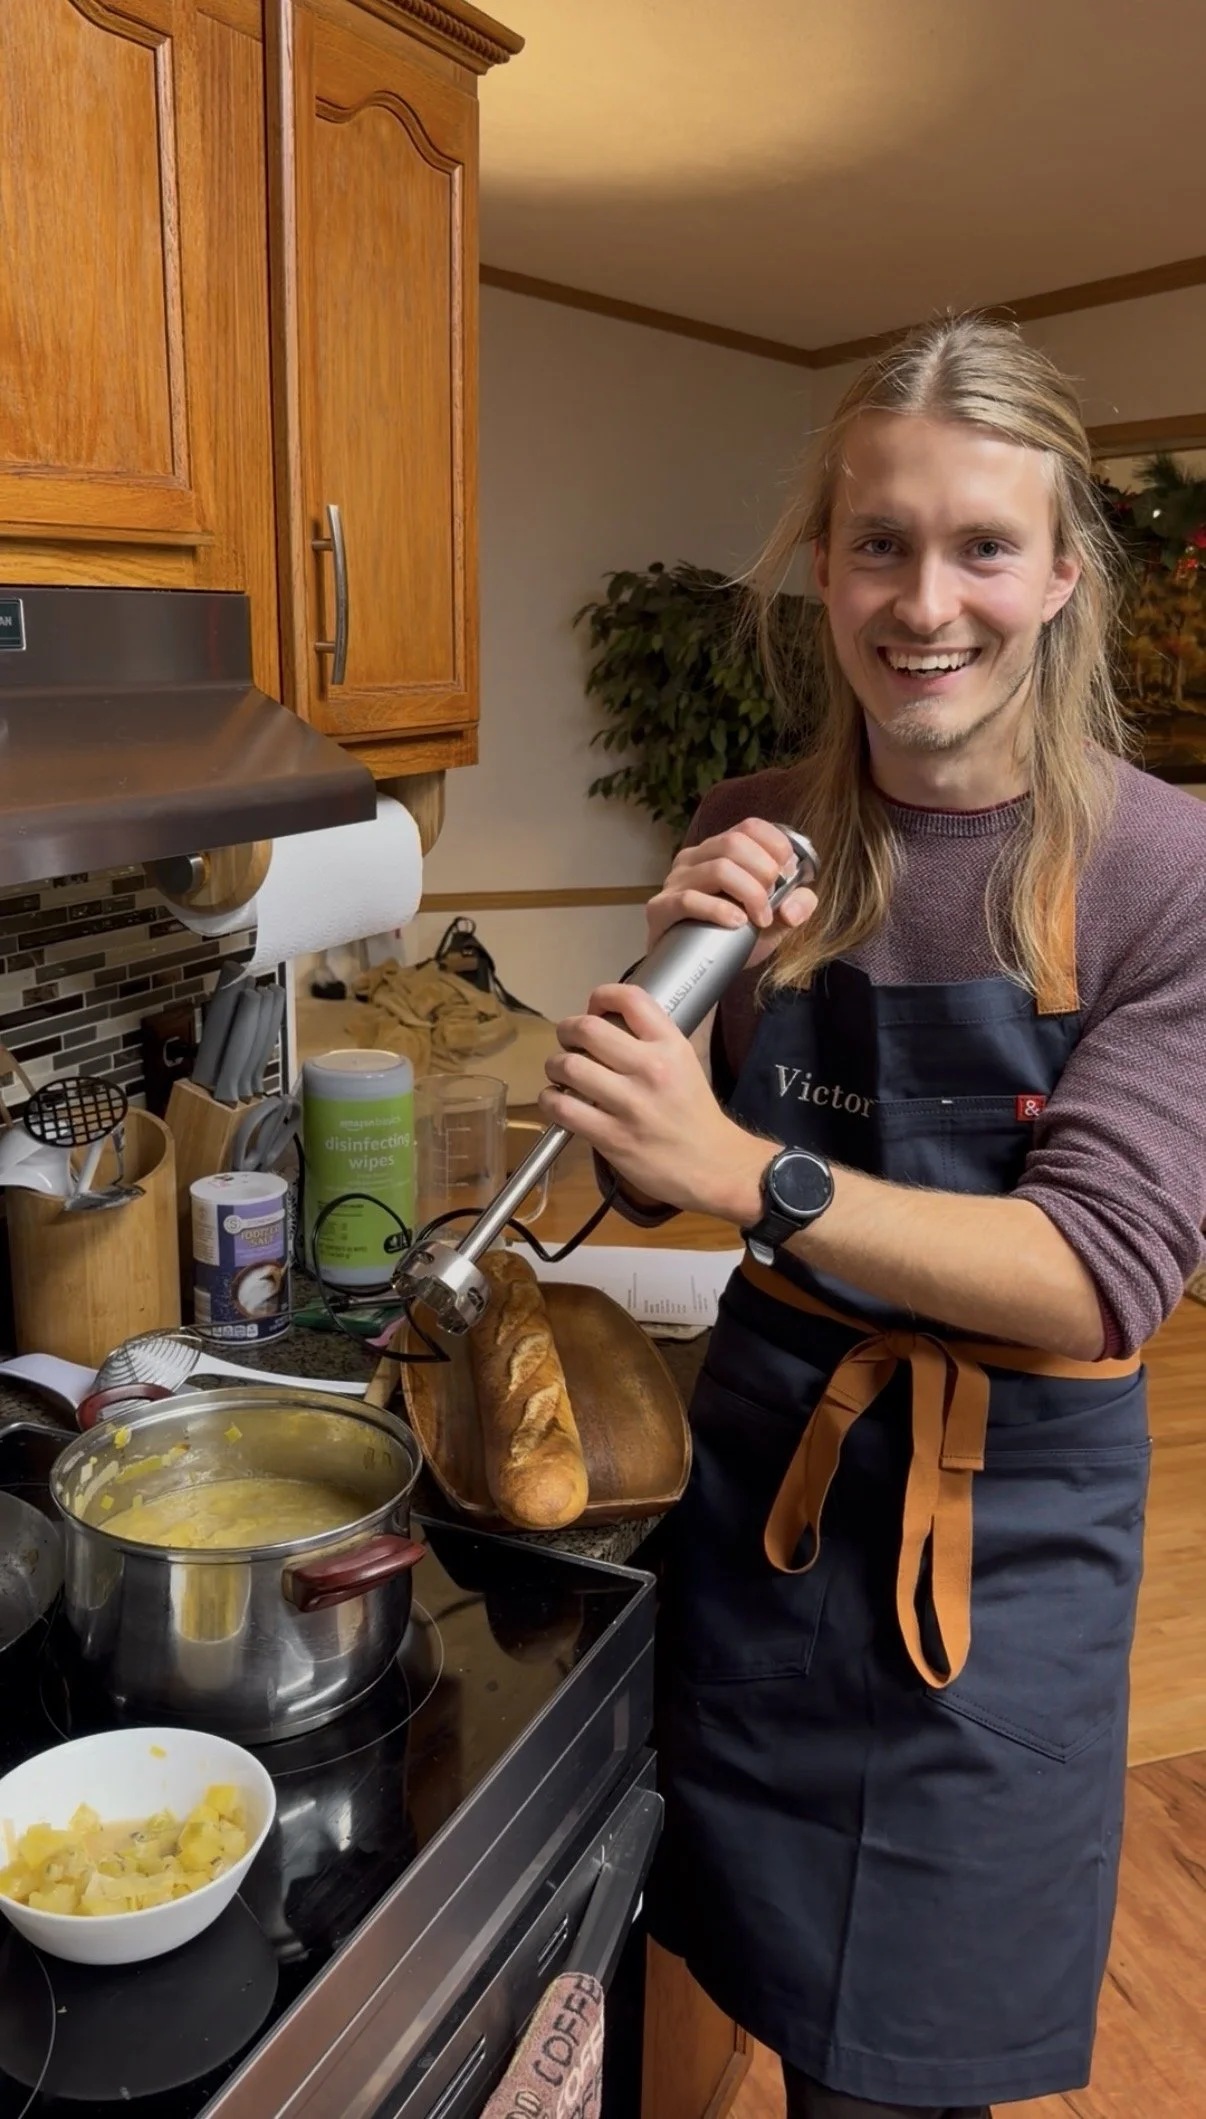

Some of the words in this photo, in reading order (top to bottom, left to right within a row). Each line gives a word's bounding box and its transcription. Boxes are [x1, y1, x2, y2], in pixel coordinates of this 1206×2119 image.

[774, 1063, 879, 1119] Victor
[325, 1132, 410, 1152] disinfecting
[348, 1154, 395, 1172] wipes
